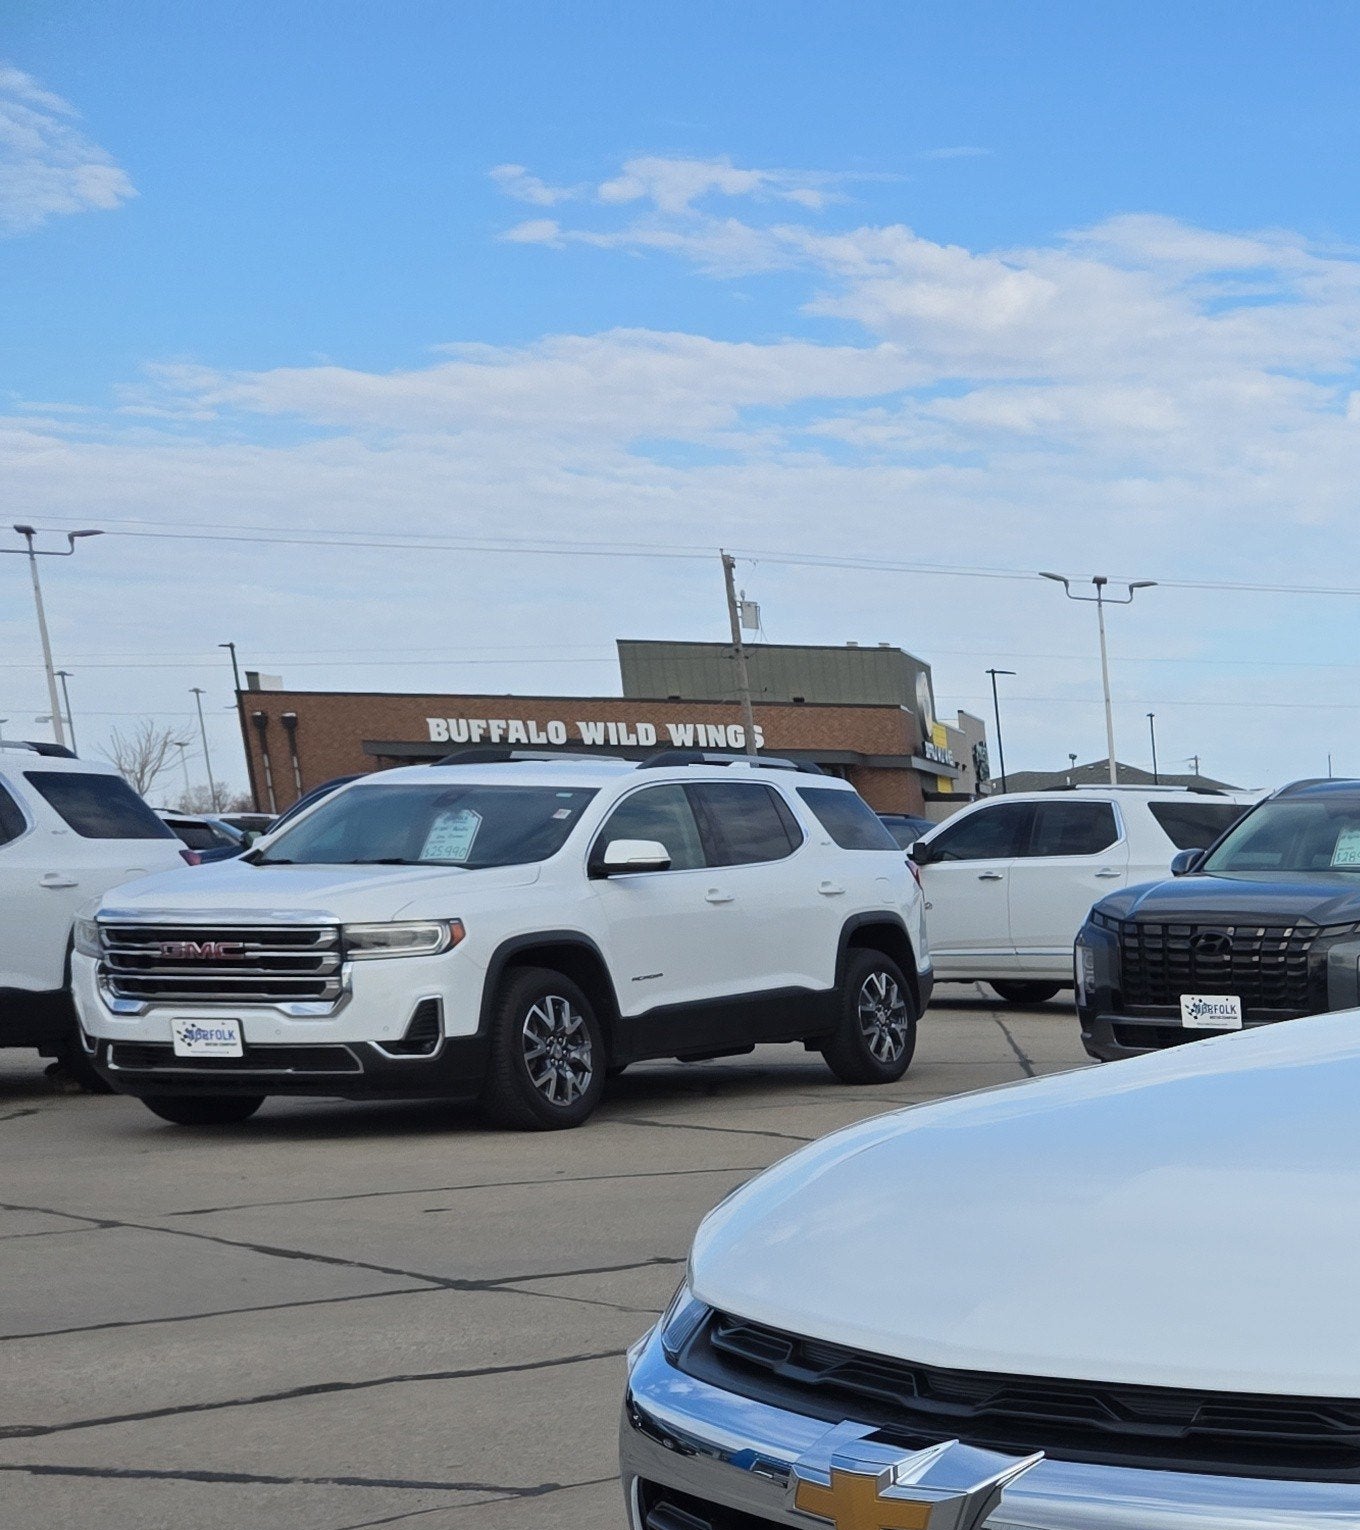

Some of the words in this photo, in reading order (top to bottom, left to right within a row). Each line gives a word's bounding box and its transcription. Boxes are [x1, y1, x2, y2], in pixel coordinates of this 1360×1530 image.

[426, 717, 567, 745] BUFFALO
[576, 721, 657, 747] WILD
[666, 723, 765, 749] WINGS
[161, 941, 244, 959] GMC
